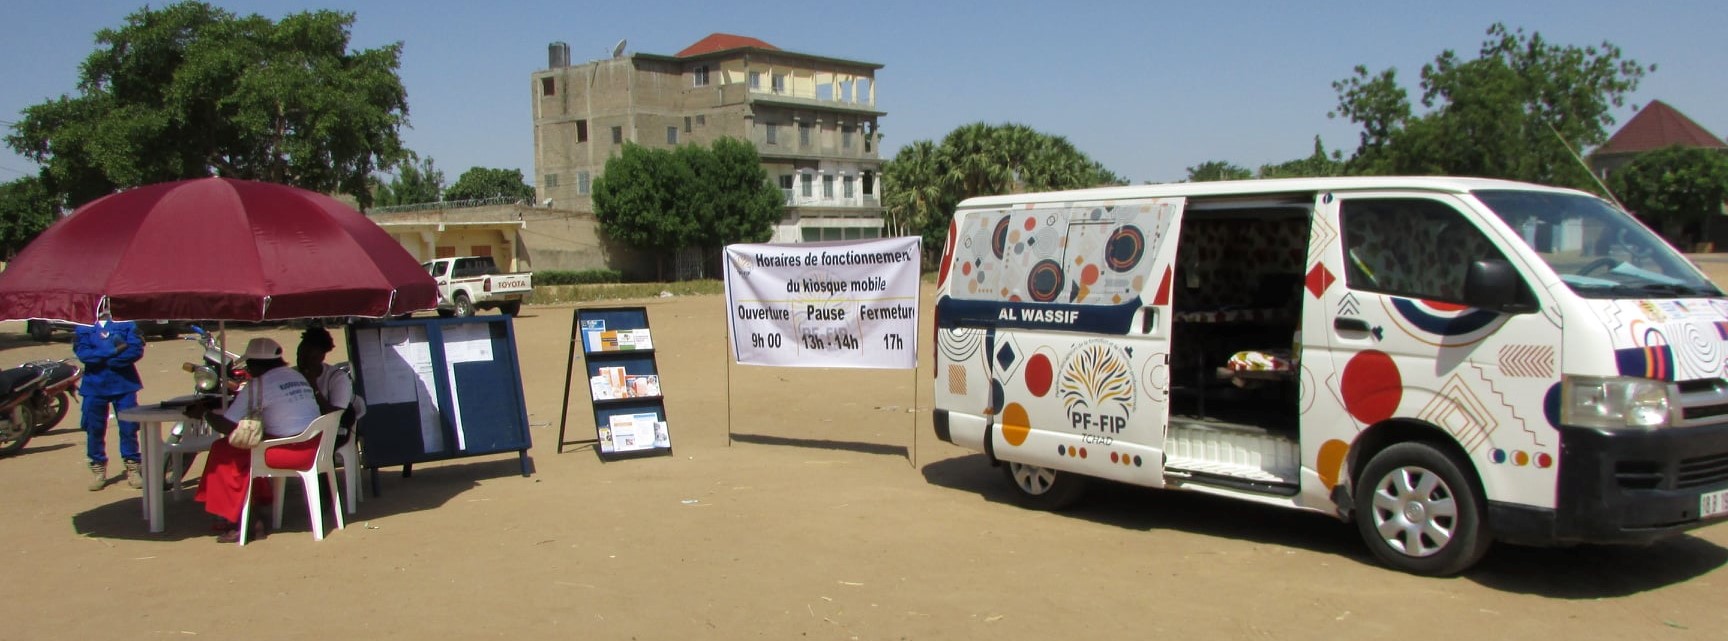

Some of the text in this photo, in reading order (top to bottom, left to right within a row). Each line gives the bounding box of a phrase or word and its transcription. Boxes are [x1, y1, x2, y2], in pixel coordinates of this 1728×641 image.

[755, 248, 912, 268] Horaires de fonctionnemen
[498, 281, 526, 289] TOYOTA
[786, 276, 886, 296] du kiosque mobile
[738, 305, 790, 320] Ouverture
[807, 305, 845, 321] Pause
[998, 308, 1079, 324] AL WASSIF
[751, 333, 782, 349] 9h 00
[801, 333, 825, 350] 13h
[834, 333, 859, 350] 14h
[883, 333, 903, 350] 17h
[1072, 412, 1127, 433] PF-FIP
[1081, 433, 1113, 446] TCHAD
